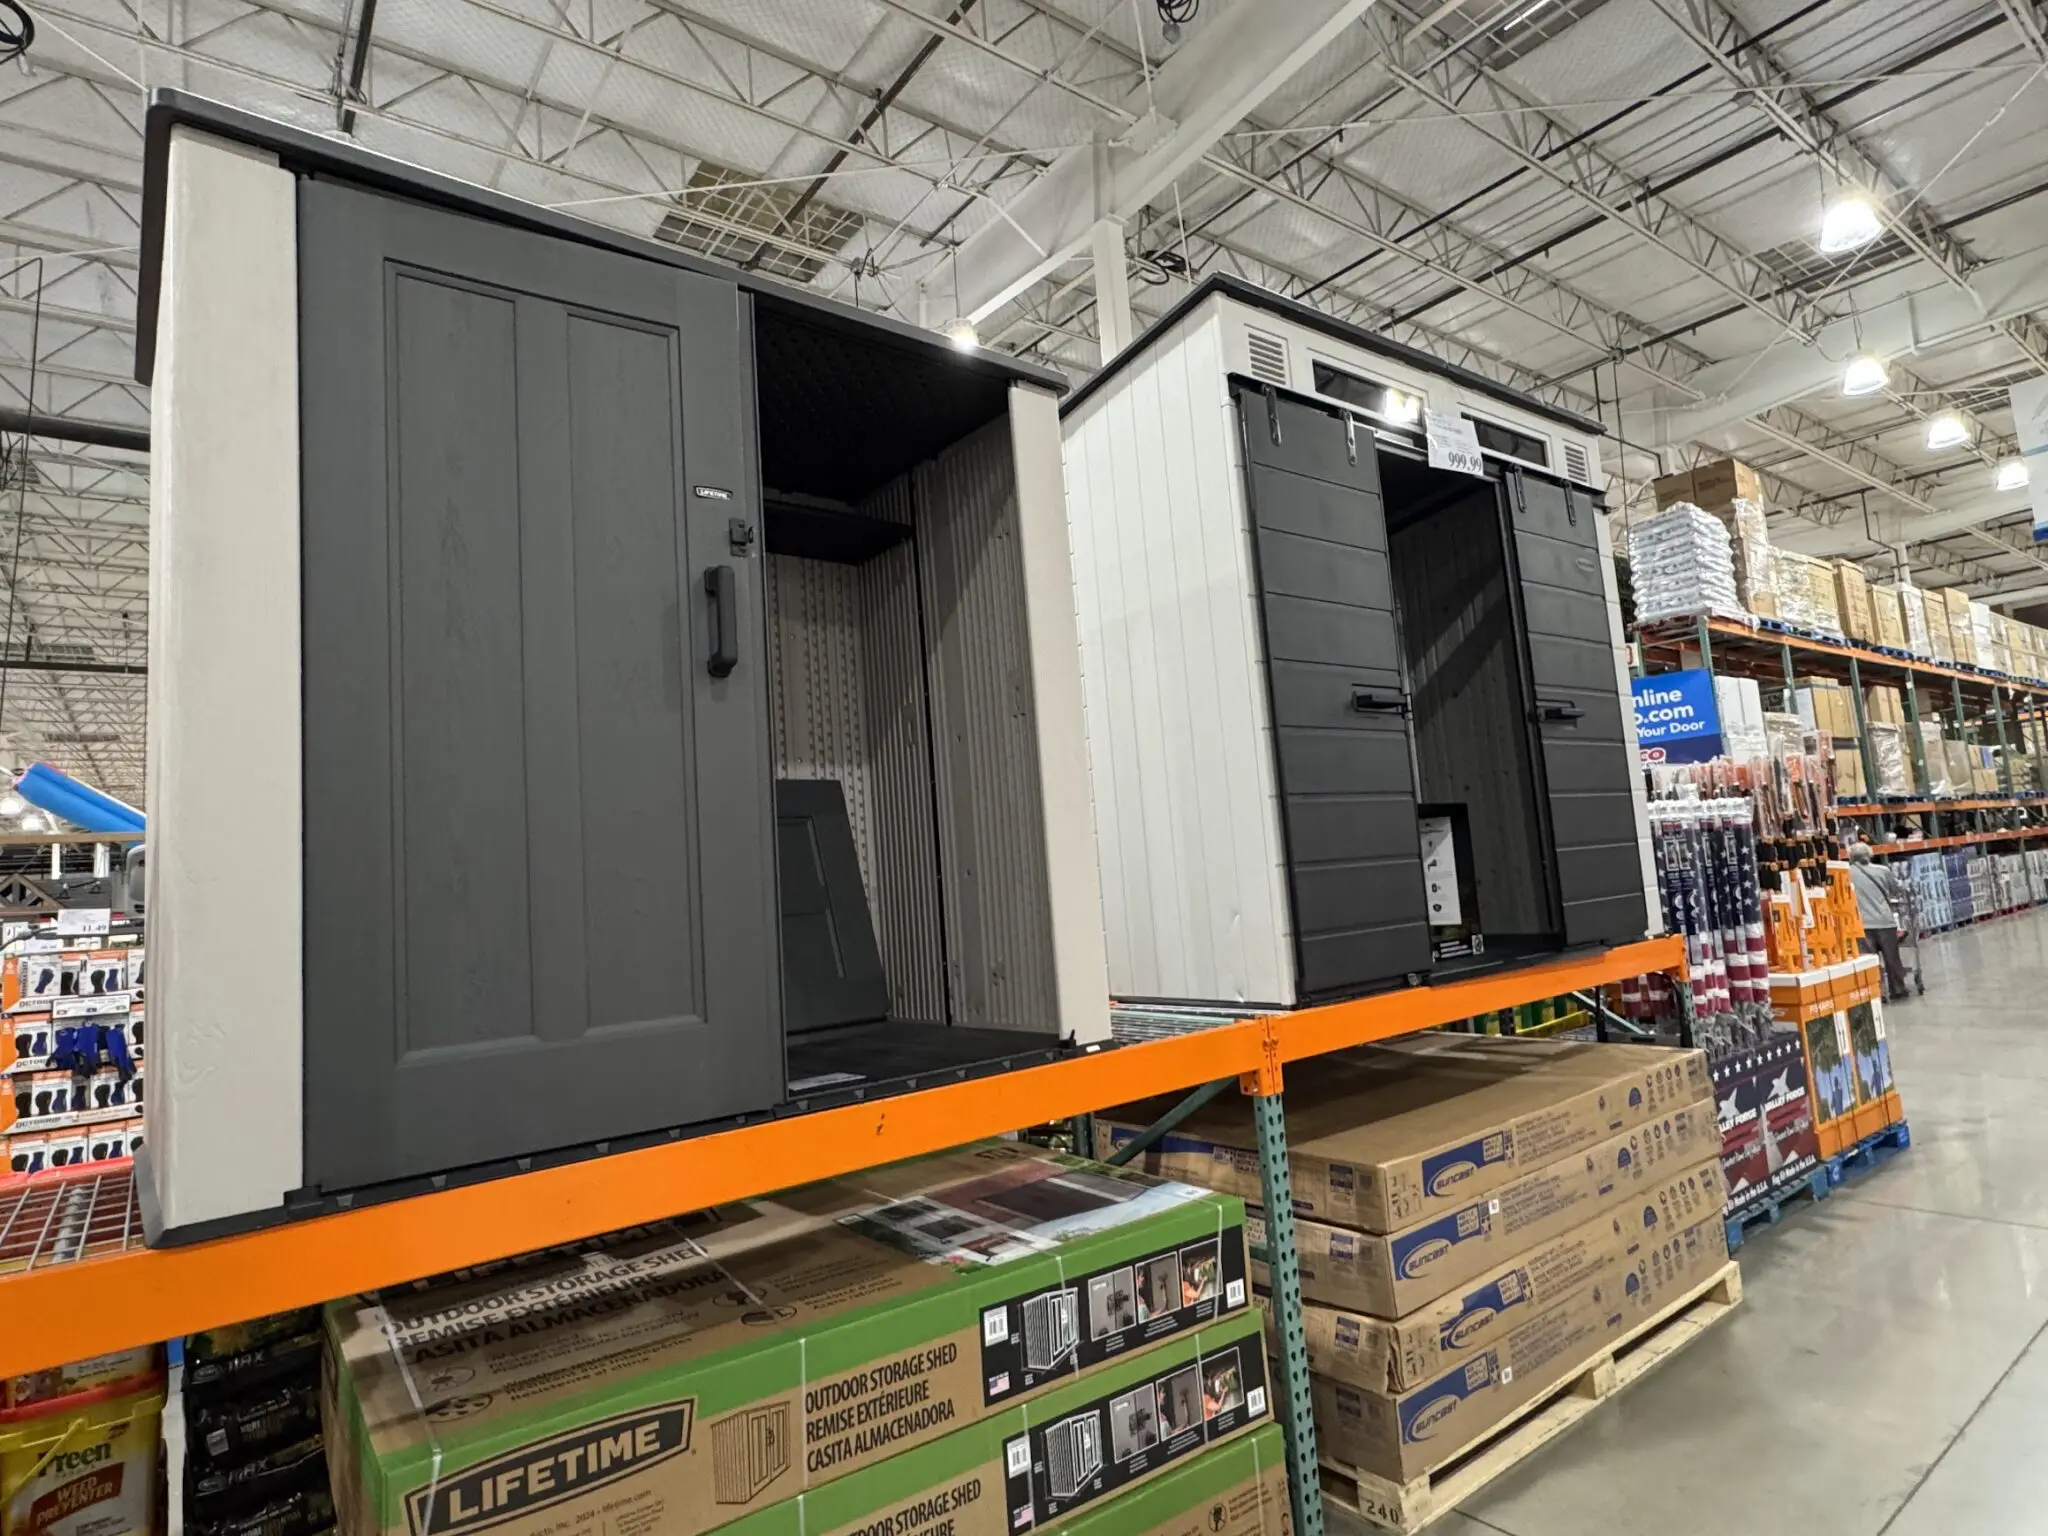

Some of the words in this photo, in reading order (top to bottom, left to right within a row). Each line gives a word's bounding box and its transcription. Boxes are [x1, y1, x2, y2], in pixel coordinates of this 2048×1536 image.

[1448, 451, 1482, 472] 999.99
[1636, 727, 1667, 737] Your
[1669, 721, 1705, 733] Door
[381, 1291, 525, 1335] OUTDOOR
[526, 1260, 643, 1302] STORAGE
[642, 1244, 708, 1270] SHED
[388, 1312, 503, 1348] REMISE
[805, 1374, 867, 1414] OUTDOOR
[869, 1352, 925, 1392] STORAGE
[925, 1342, 957, 1371] SHED
[806, 1410, 854, 1445] REMISE
[857, 1379, 930, 1426] EXTÉRIEURE
[807, 1438, 852, 1473] CASITA
[854, 1398, 956, 1456] ALMACENADORA
[450, 1420, 661, 1524] LIFETIME
[895, 1491, 950, 1535] STORAGE
[950, 1478, 981, 1510] SHED
